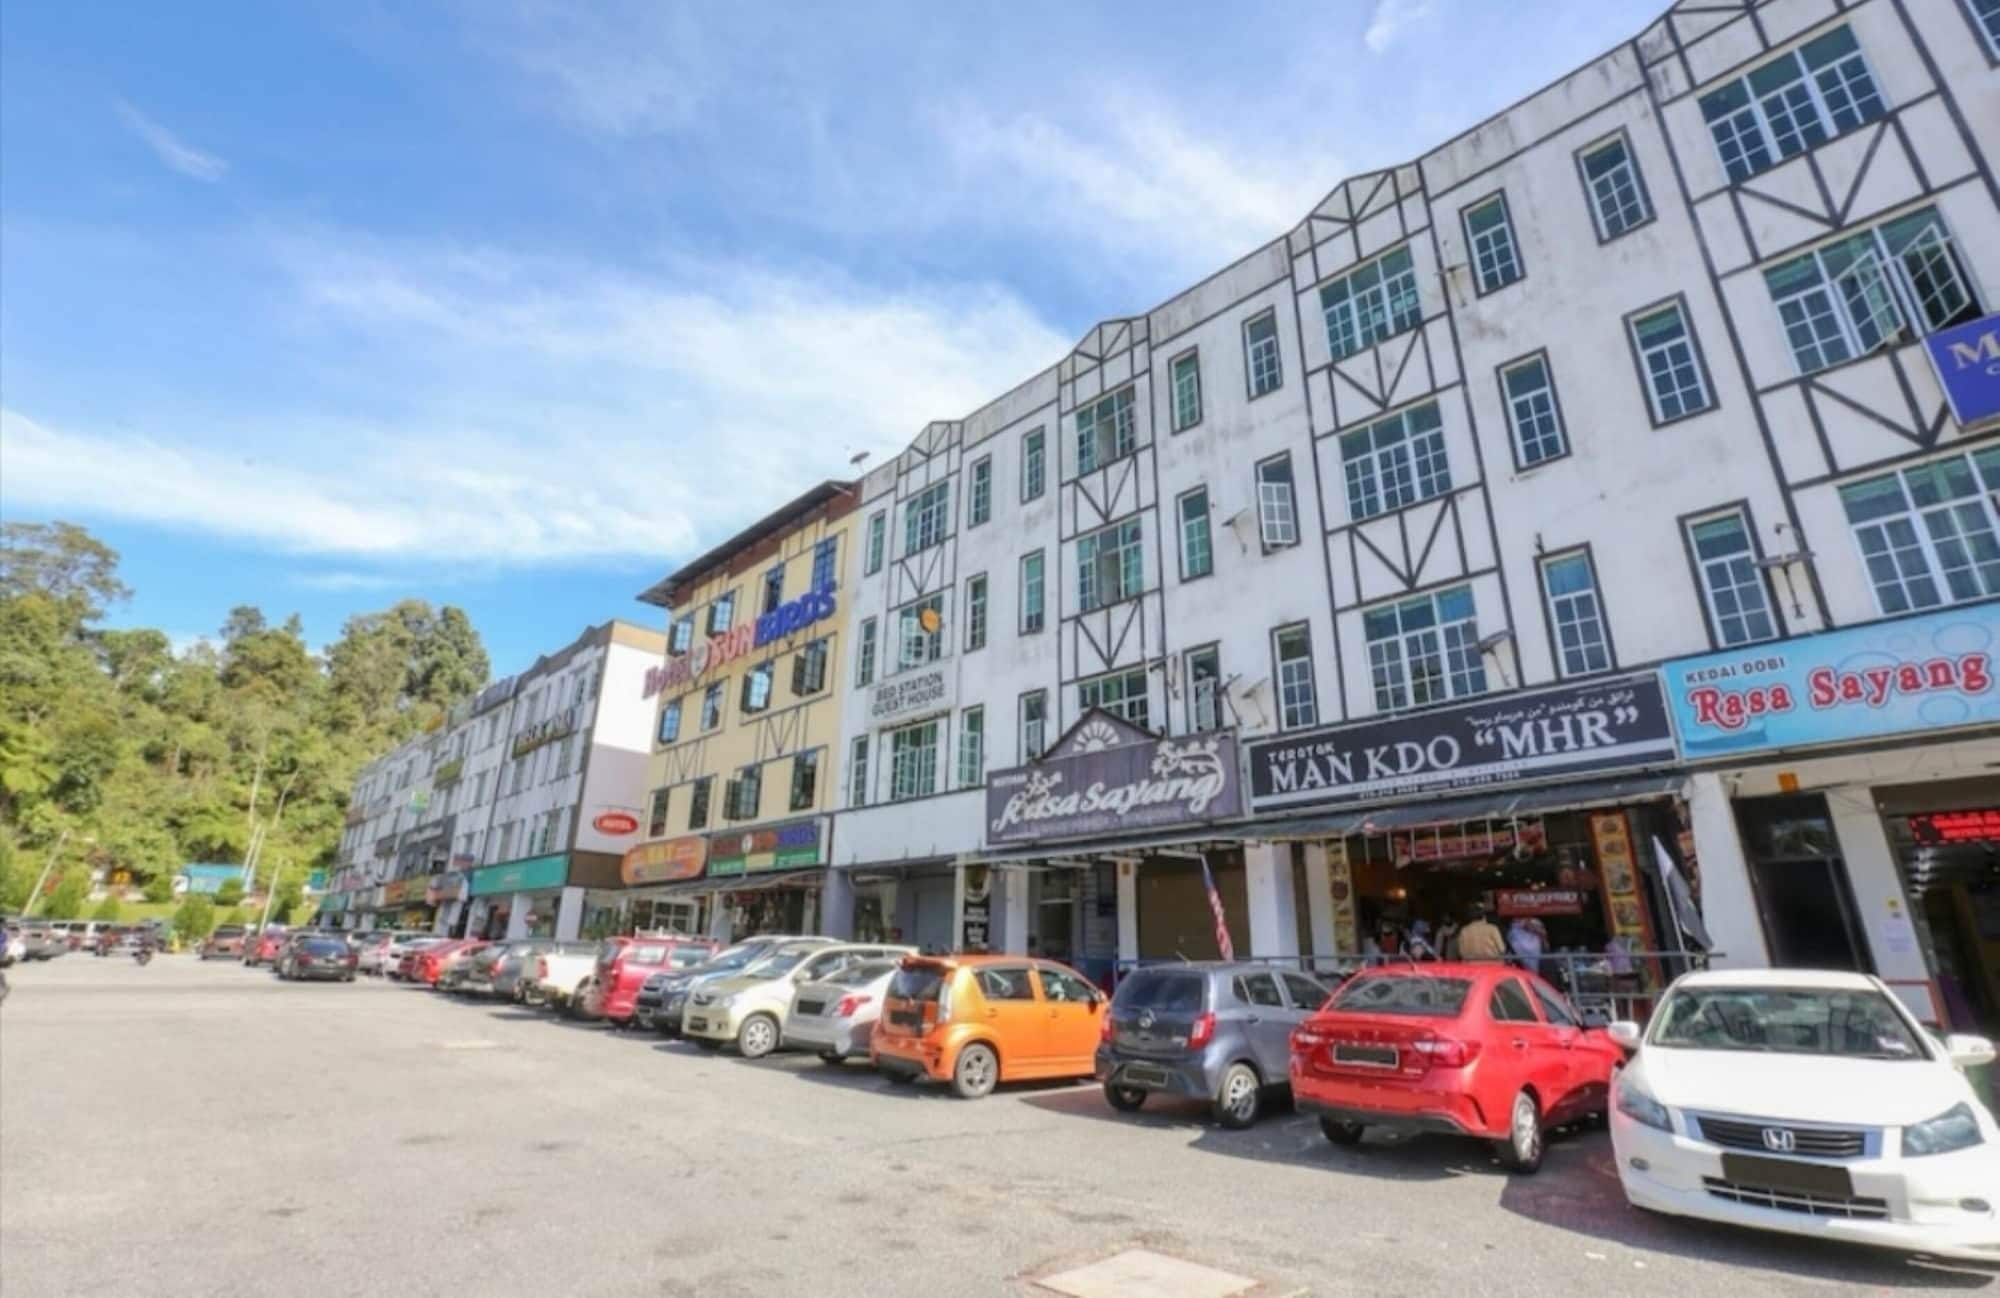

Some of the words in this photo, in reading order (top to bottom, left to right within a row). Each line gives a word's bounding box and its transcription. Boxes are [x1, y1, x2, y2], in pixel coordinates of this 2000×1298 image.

[899, 671, 944, 696] STATION
[1685, 667, 1736, 684] KEDAI
[1742, 656, 1786, 676] DOBI
[1688, 684, 1794, 731] Rasa
[1808, 651, 1992, 710] Sayang
[871, 694, 906, 717] GUEST
[907, 683, 945, 705] HOUSE
[1269, 751, 1354, 793] MAN
[1365, 734, 1461, 781] KDO
[992, 788, 1080, 832] Rasa
[1080, 774, 1222, 815] Sayang
